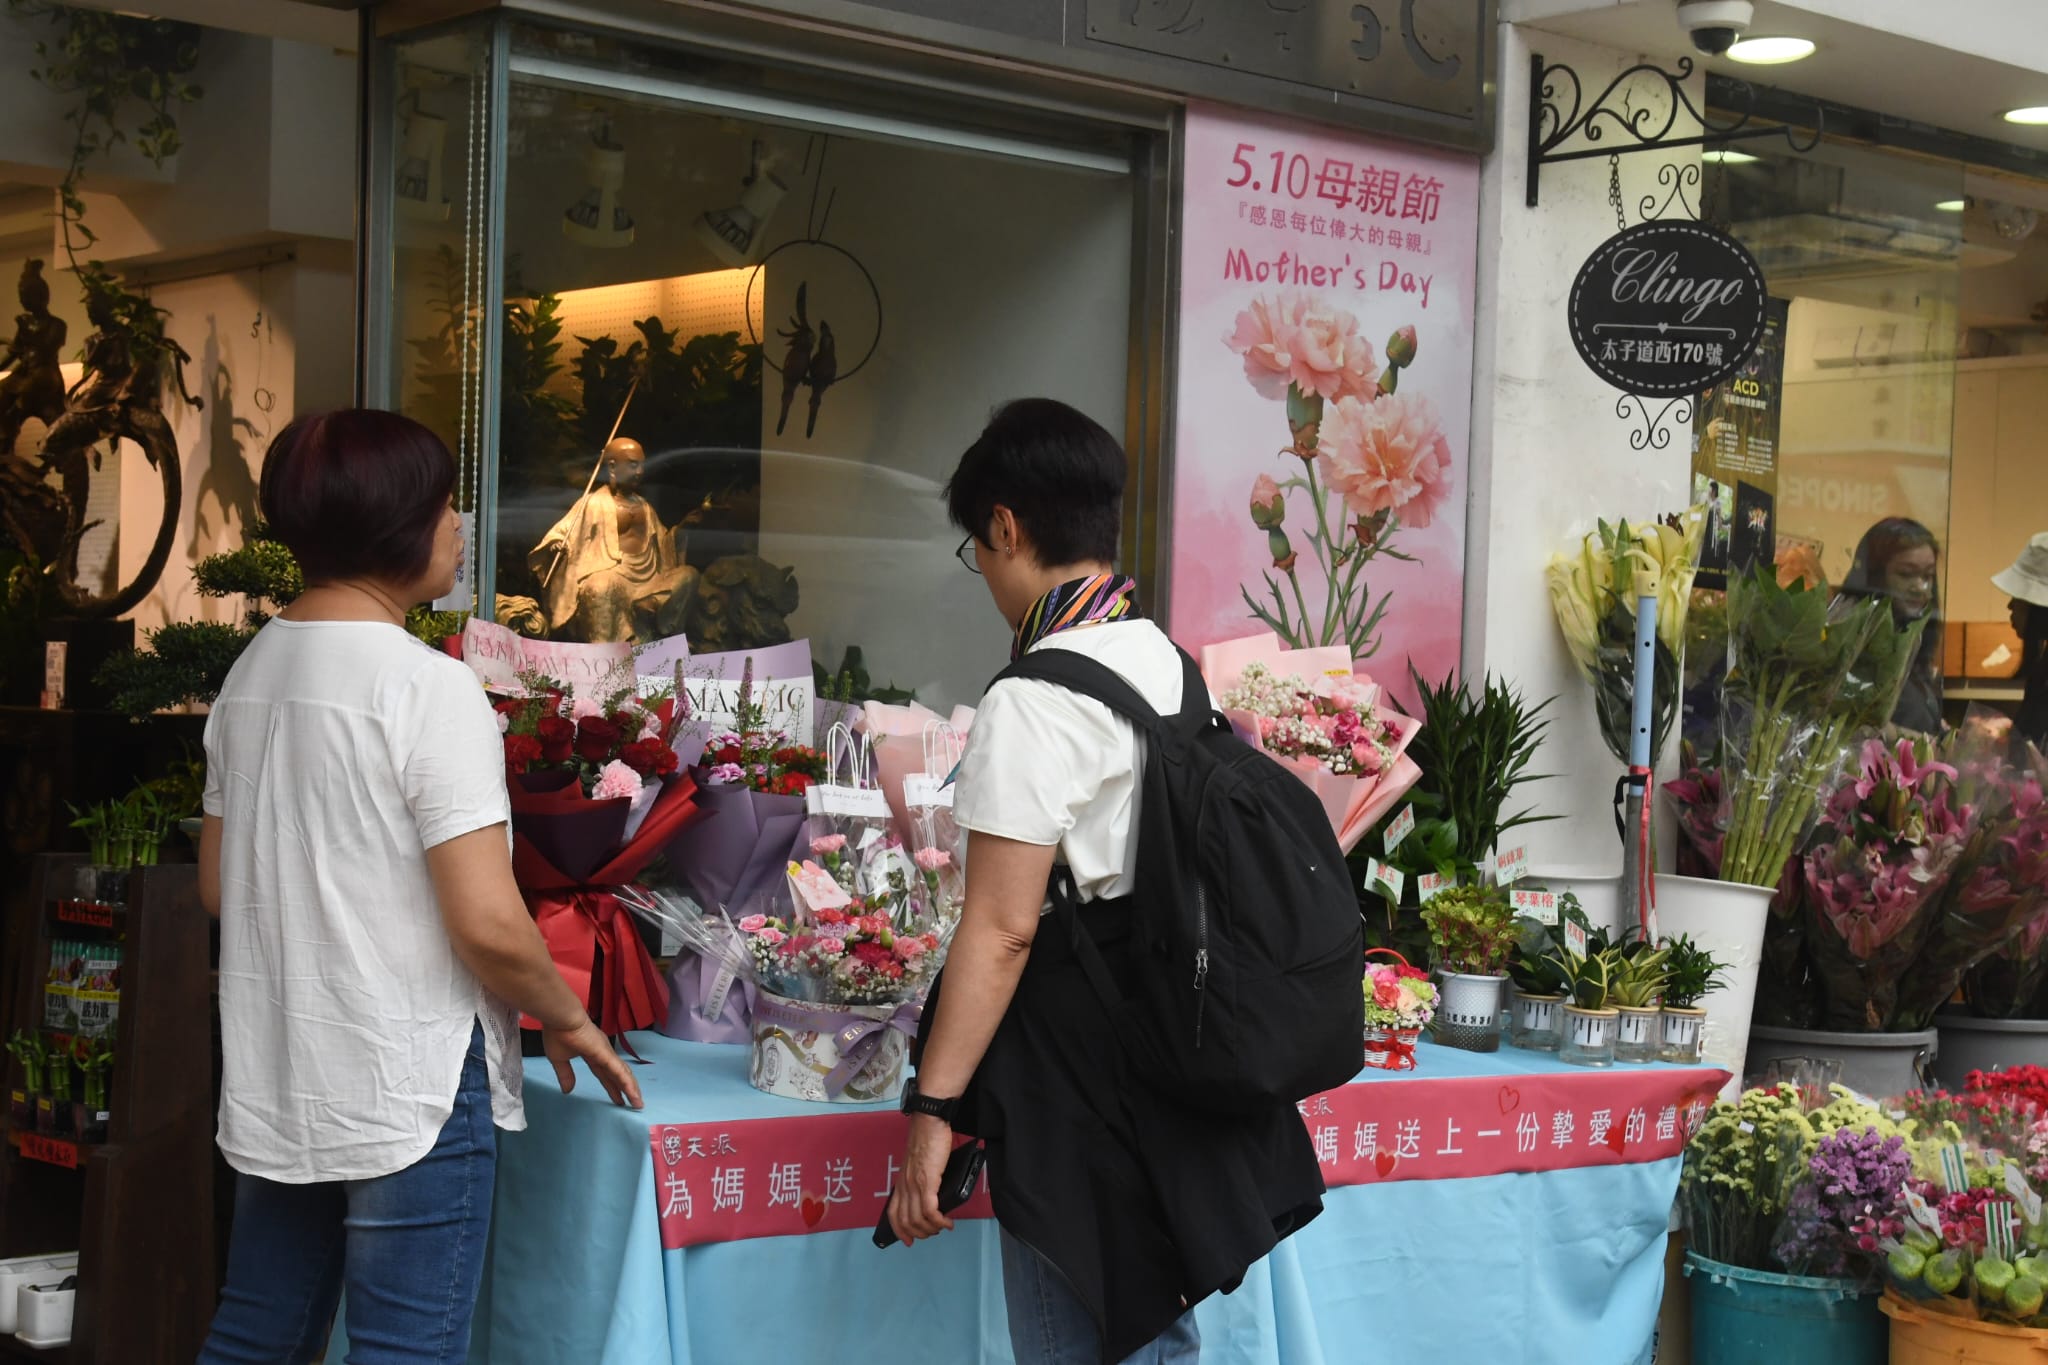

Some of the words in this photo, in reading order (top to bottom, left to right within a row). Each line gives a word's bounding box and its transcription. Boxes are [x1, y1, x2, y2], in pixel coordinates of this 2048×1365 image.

[1227, 143, 1444, 225] 5.10母親節
[1224, 248, 1366, 290] Mother's
[1378, 261, 1433, 309] Day
[1611, 248, 1744, 324] Clingo
[1601, 338, 1723, 366] 太子道西170號
[1733, 379, 1760, 396] ACD
[662, 1155, 900, 1220] 為媽媽送上
